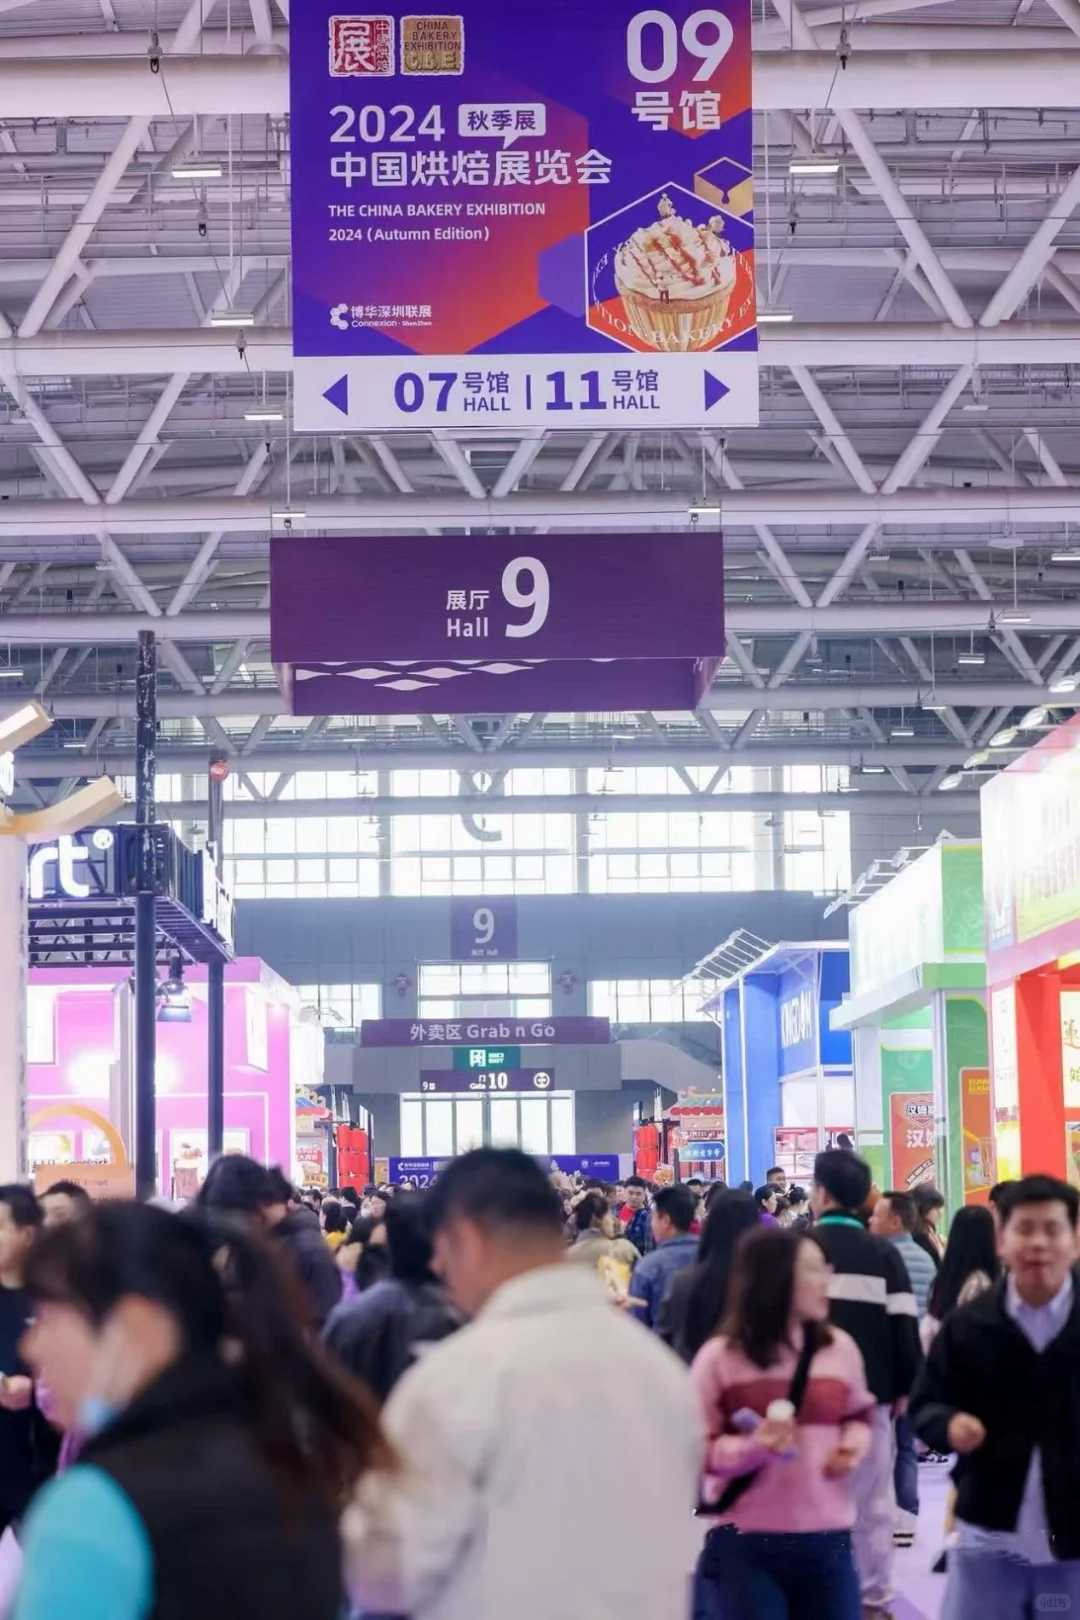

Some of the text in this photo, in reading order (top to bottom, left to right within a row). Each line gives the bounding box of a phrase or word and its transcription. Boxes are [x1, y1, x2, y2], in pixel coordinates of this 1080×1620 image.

[416, 21, 448, 30] CHINA
[412, 31, 457, 41] BAKERY
[334, 22, 375, 71] 展
[404, 41, 461, 51] EXHIBITION
[627, 9, 734, 83] 09
[467, 109, 537, 131] 秋季展
[631, 90, 721, 131] 号馆
[329, 105, 445, 143] 2024
[331, 149, 613, 187] 中国烘焙展览会
[328, 203, 546, 217] THE CHINA BAKERY EXHIBITION
[328, 226, 490, 242] 2024 (Autumn Edition)
[350, 305, 432, 318] 博华深圳联展
[351, 320, 397, 328] Connexion
[394, 371, 510, 413] 07 号馆
[546, 370, 659, 410] 11 号馆
[463, 397, 511, 411] HALL
[612, 396, 660, 409] HALL
[446, 556, 550, 638] 展厅 9
[446, 617, 489, 637] Hall
[472, 908, 495, 944] 9
[410, 1023, 555, 1041] 外卖区 Grab n Go
[488, 1072, 508, 1090] 10
